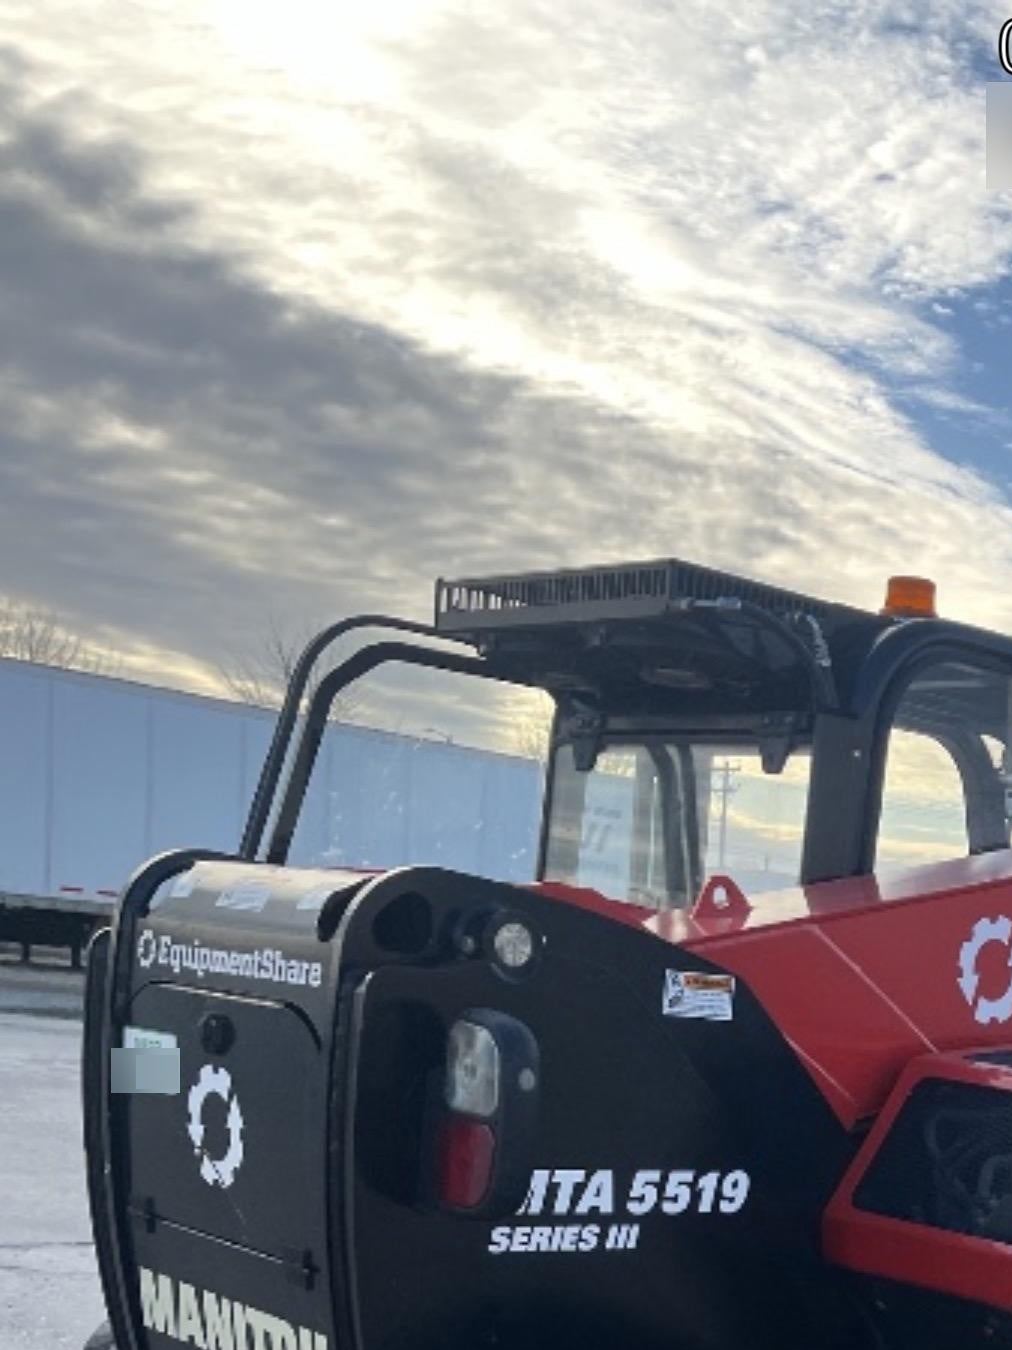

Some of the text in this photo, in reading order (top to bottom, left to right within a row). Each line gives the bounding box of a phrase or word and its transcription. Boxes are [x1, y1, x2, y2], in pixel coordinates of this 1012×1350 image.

[157, 934, 323, 988] EquipmentShare
[626, 1169, 751, 1215] 5519
[487, 1224, 640, 1254] SERIES III
